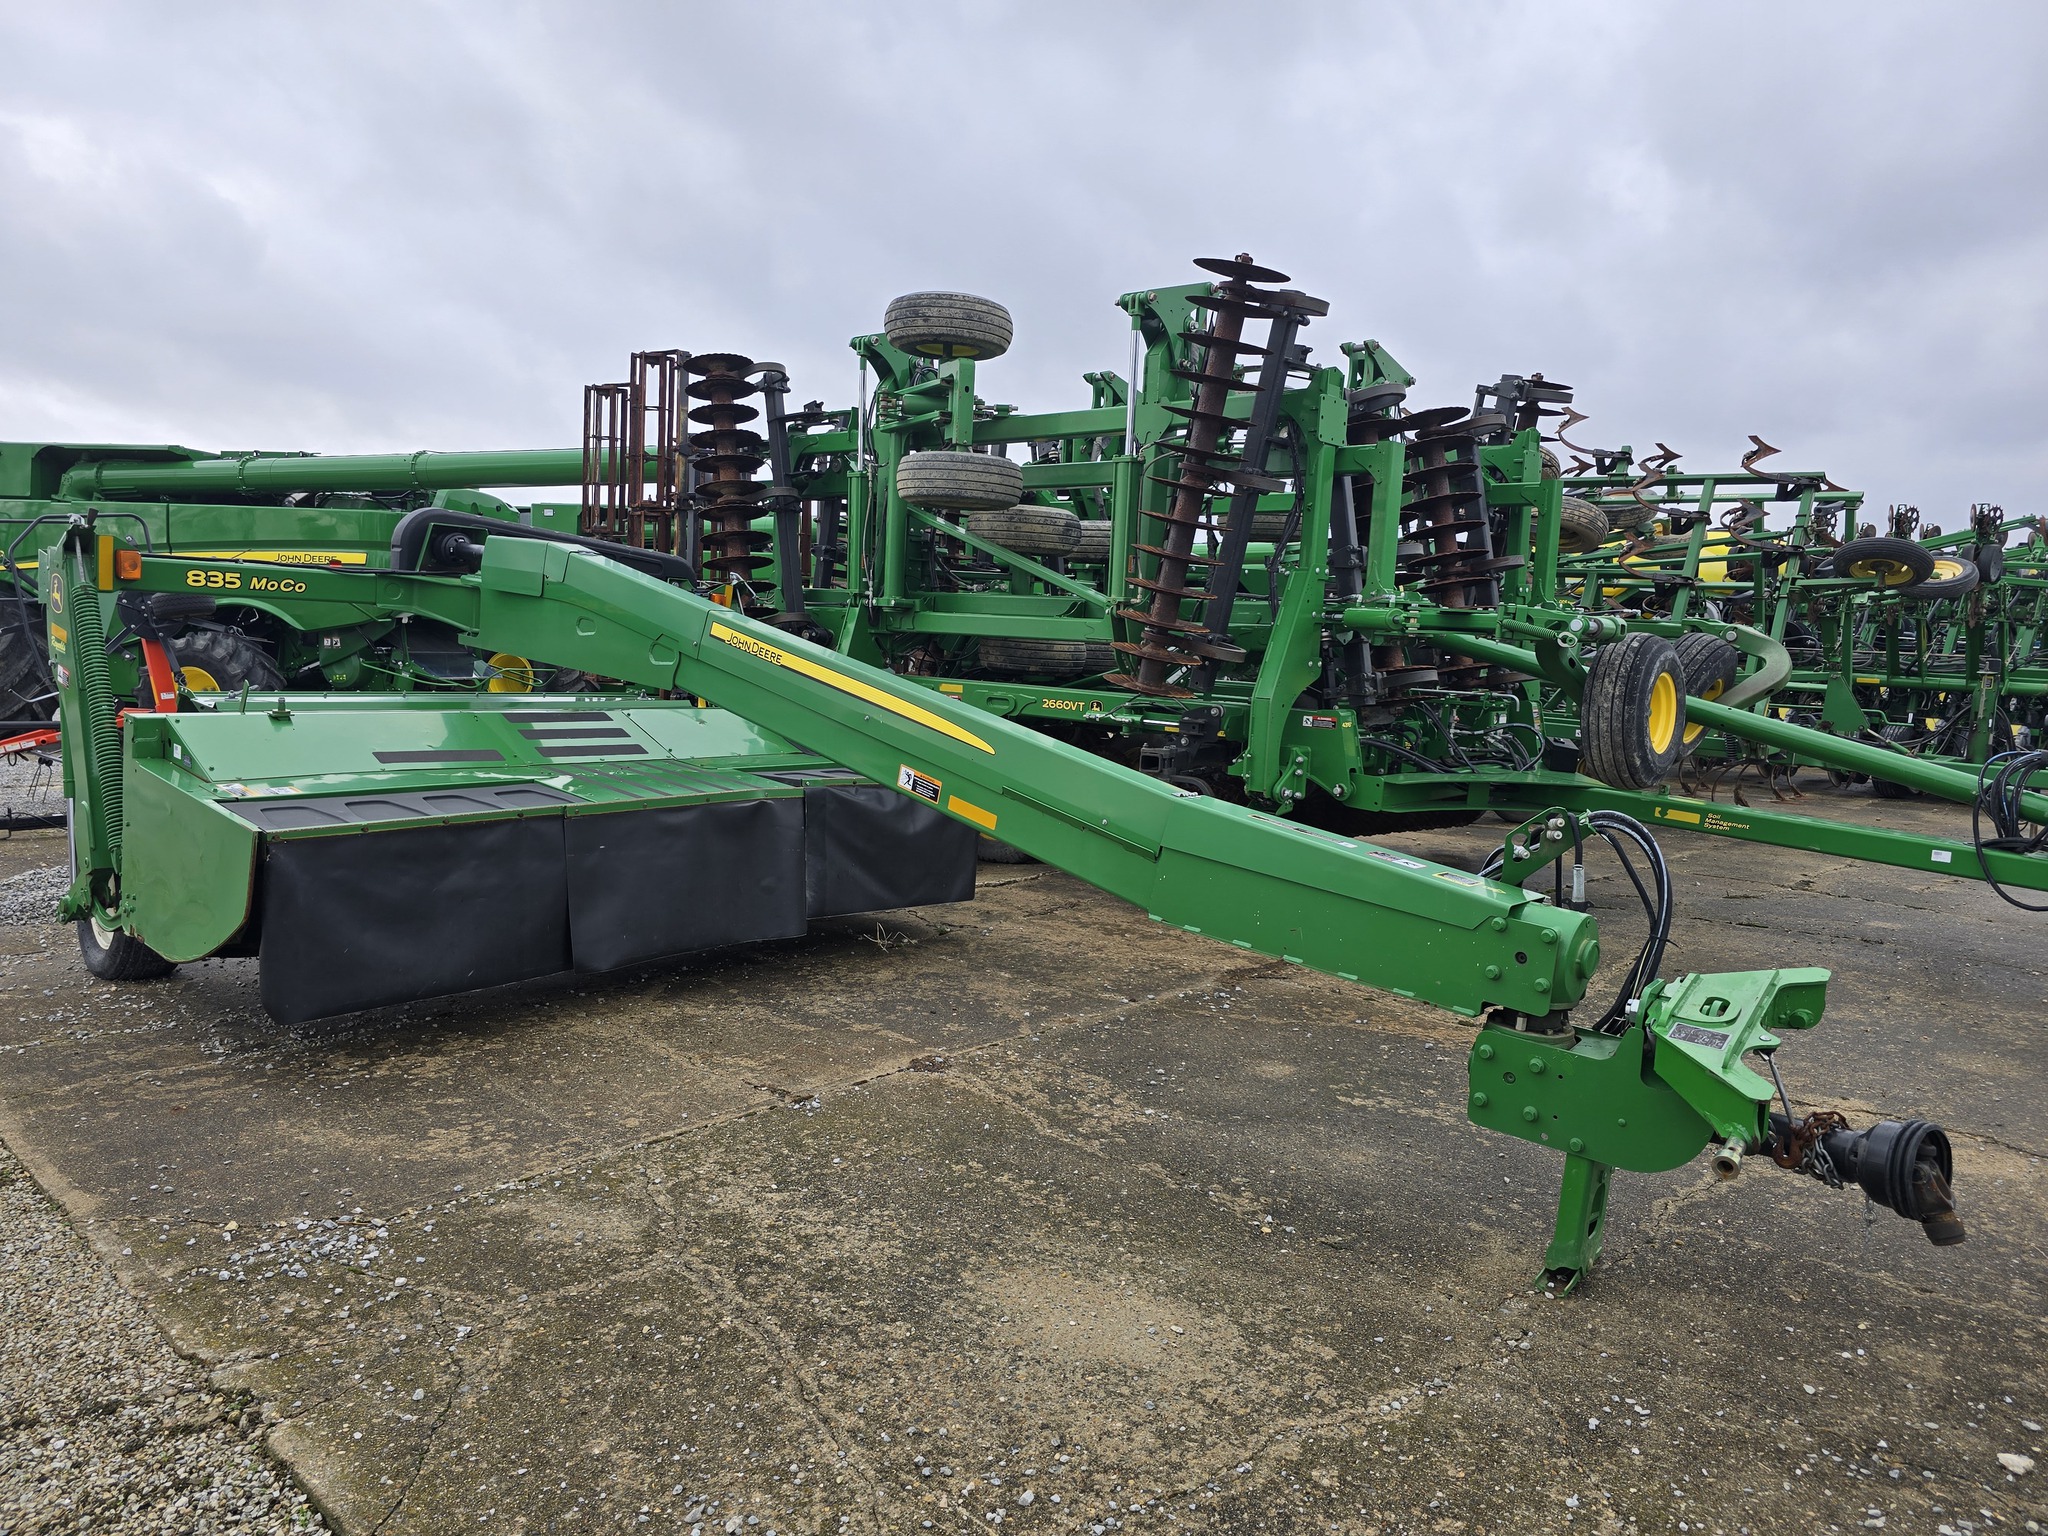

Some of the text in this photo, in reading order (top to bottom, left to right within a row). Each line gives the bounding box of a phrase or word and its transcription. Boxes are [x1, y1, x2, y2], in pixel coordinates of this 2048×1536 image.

[274, 553, 302, 562] JOHN
[186, 569, 307, 593] 835 MoCo
[726, 633, 783, 664] JOHN DEERE
[1042, 698, 1086, 712] 2660VT
[1703, 822, 1730, 831] System
[1704, 818, 1750, 830] Management
